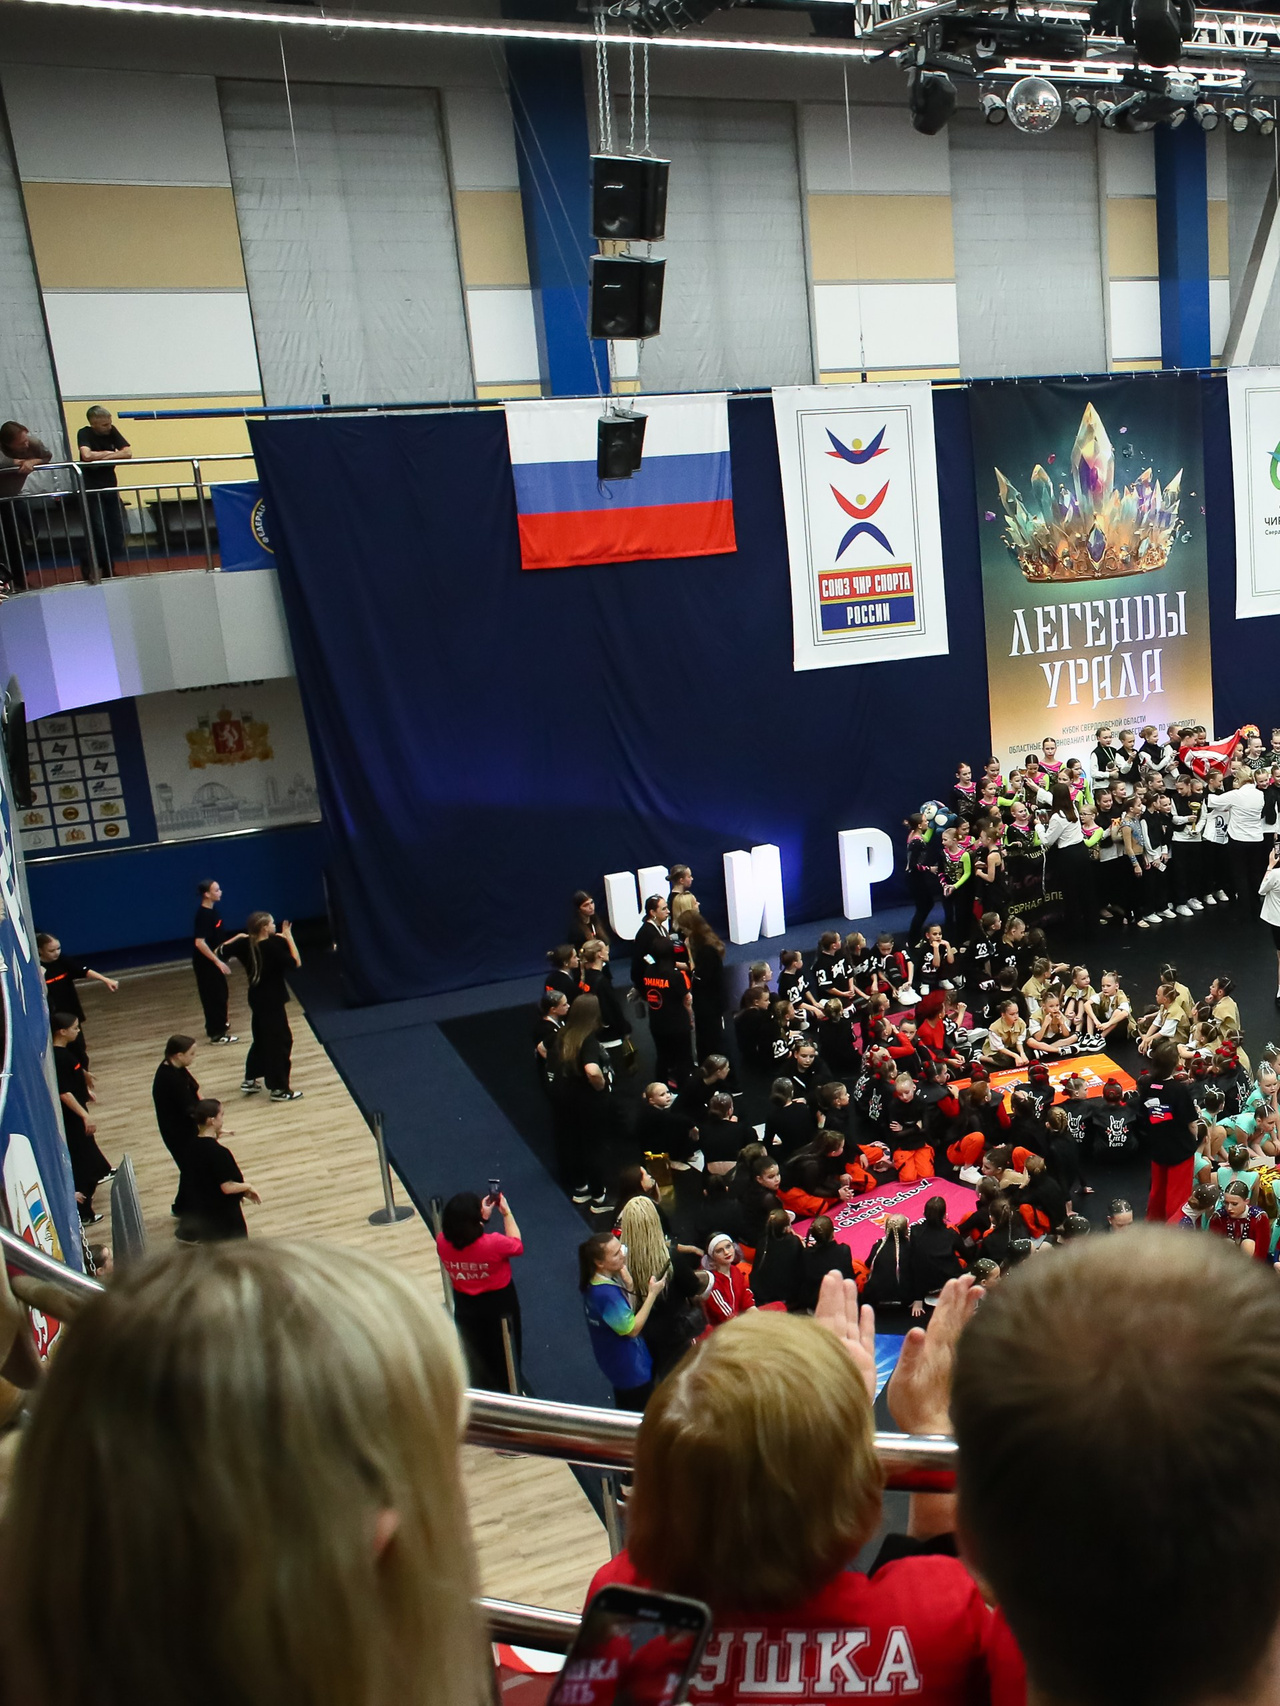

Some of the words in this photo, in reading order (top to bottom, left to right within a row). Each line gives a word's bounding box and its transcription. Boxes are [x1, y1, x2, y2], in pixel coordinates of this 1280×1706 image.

[822, 577, 850, 598] СОЮЗ
[853, 575, 872, 595] ЧИР
[874, 572, 911, 592] СПОРТА
[846, 602, 891, 625] РОССИИ
[1008, 591, 1188, 657] ЛЕГЕНДЫ
[1039, 649, 1164, 709] УРАЛА
[1062, 725, 1080, 734] КУБОК
[1124, 716, 1146, 726] ОБЛАСТИ
[1009, 741, 1042, 754] ОБЛАСТНЫЕ
[840, 1205, 884, 1227] Cheer
